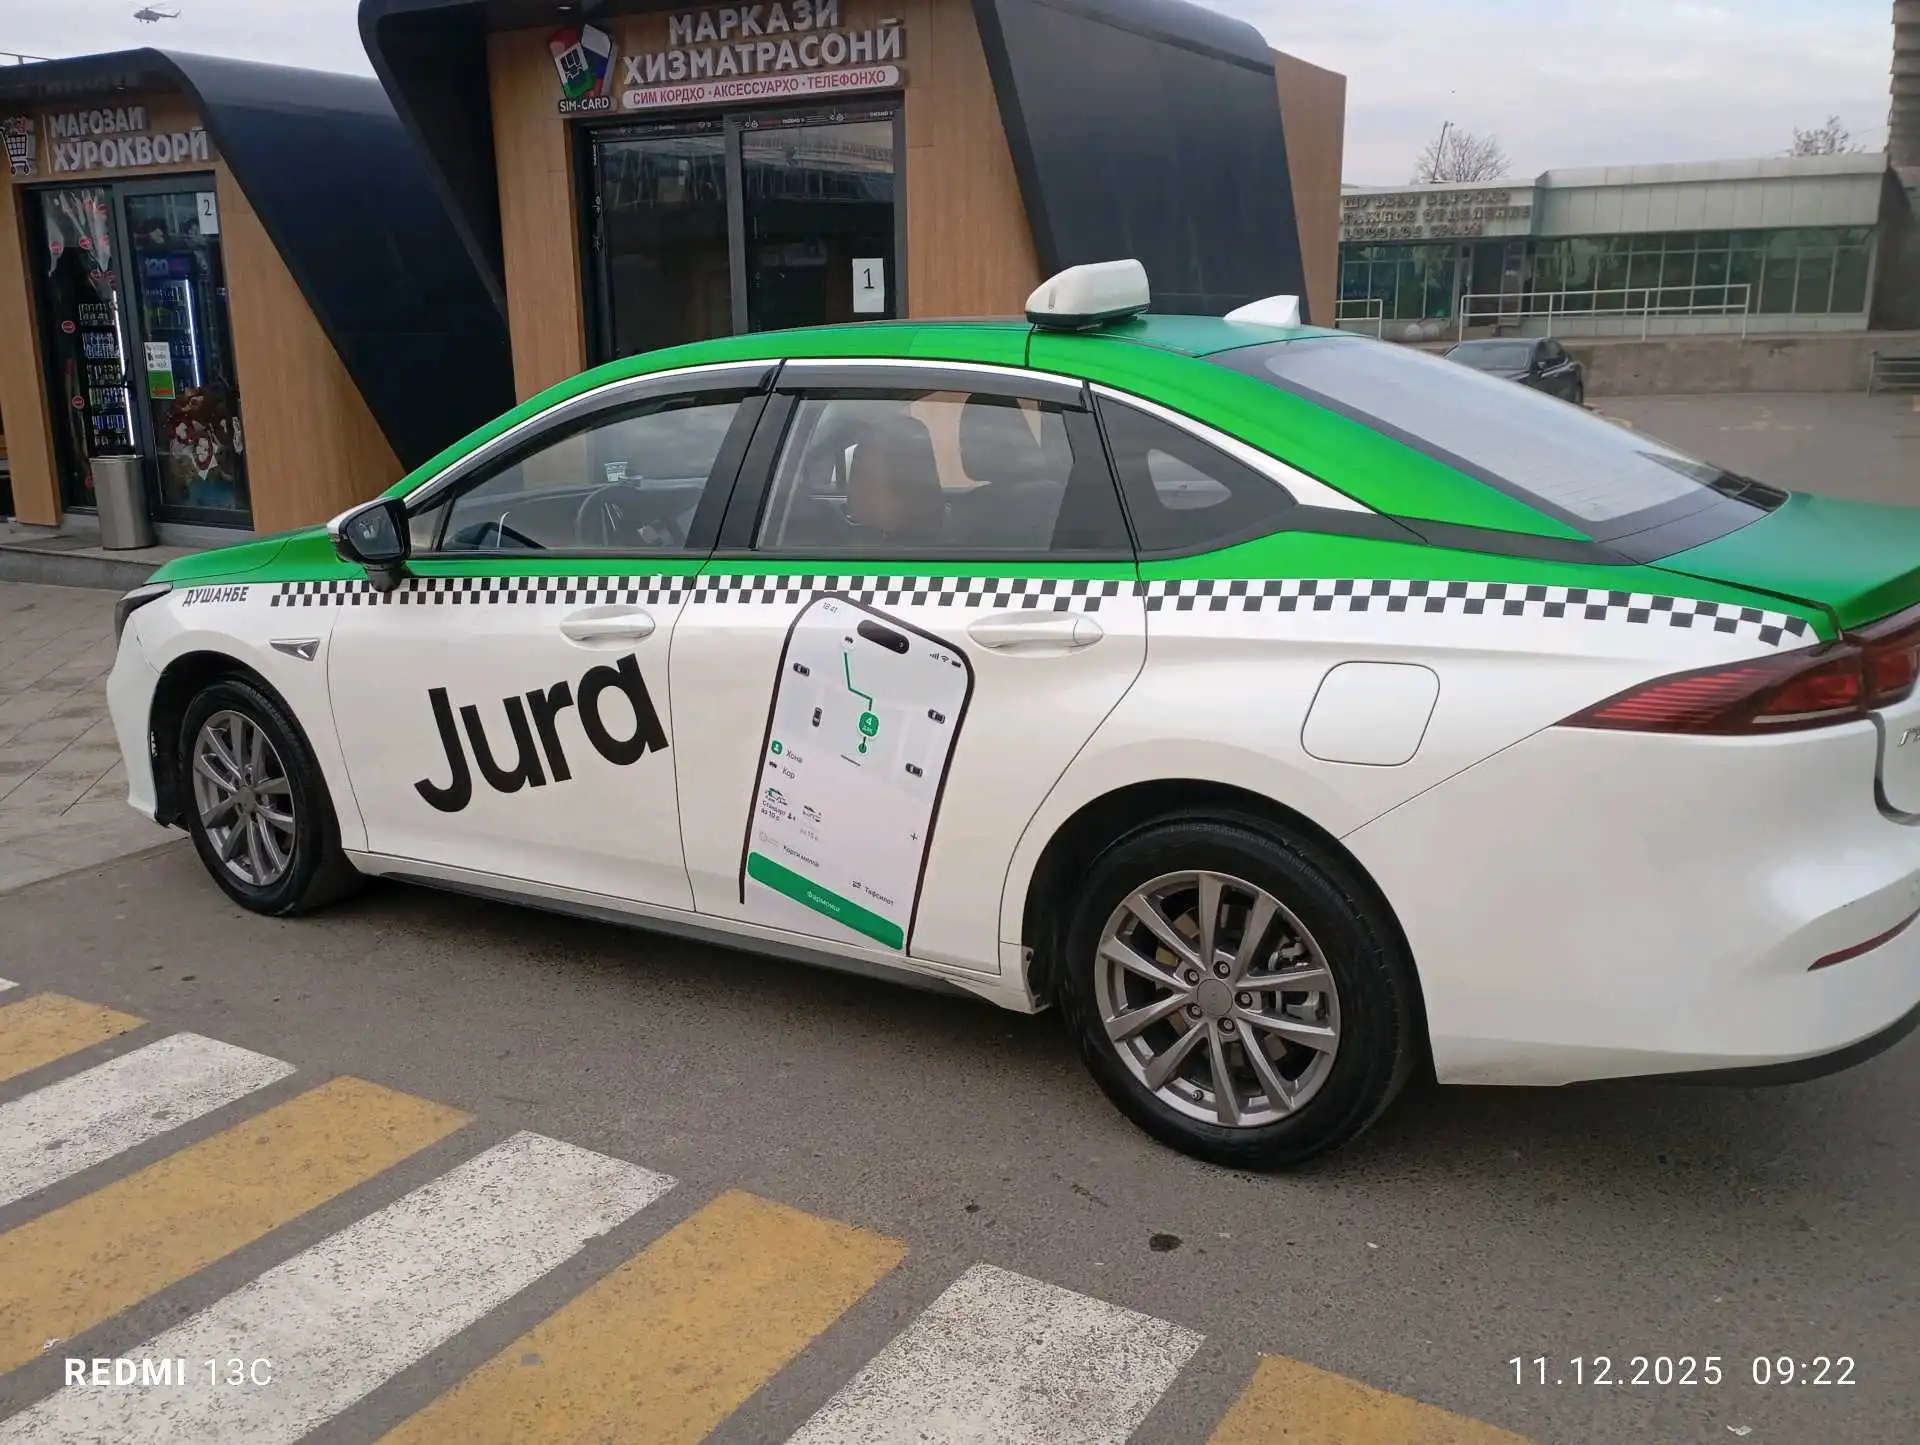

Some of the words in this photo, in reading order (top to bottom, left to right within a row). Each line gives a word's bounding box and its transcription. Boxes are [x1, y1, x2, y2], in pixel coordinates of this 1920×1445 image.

[669, 0, 840, 46] МАРКАЗИ
[633, 90, 659, 105] СИМ
[203, 199, 212, 217] 2
[863, 268, 875, 289] 1
[182, 586, 249, 607] ДУШАНБЕ
[413, 652, 670, 813] Jura
